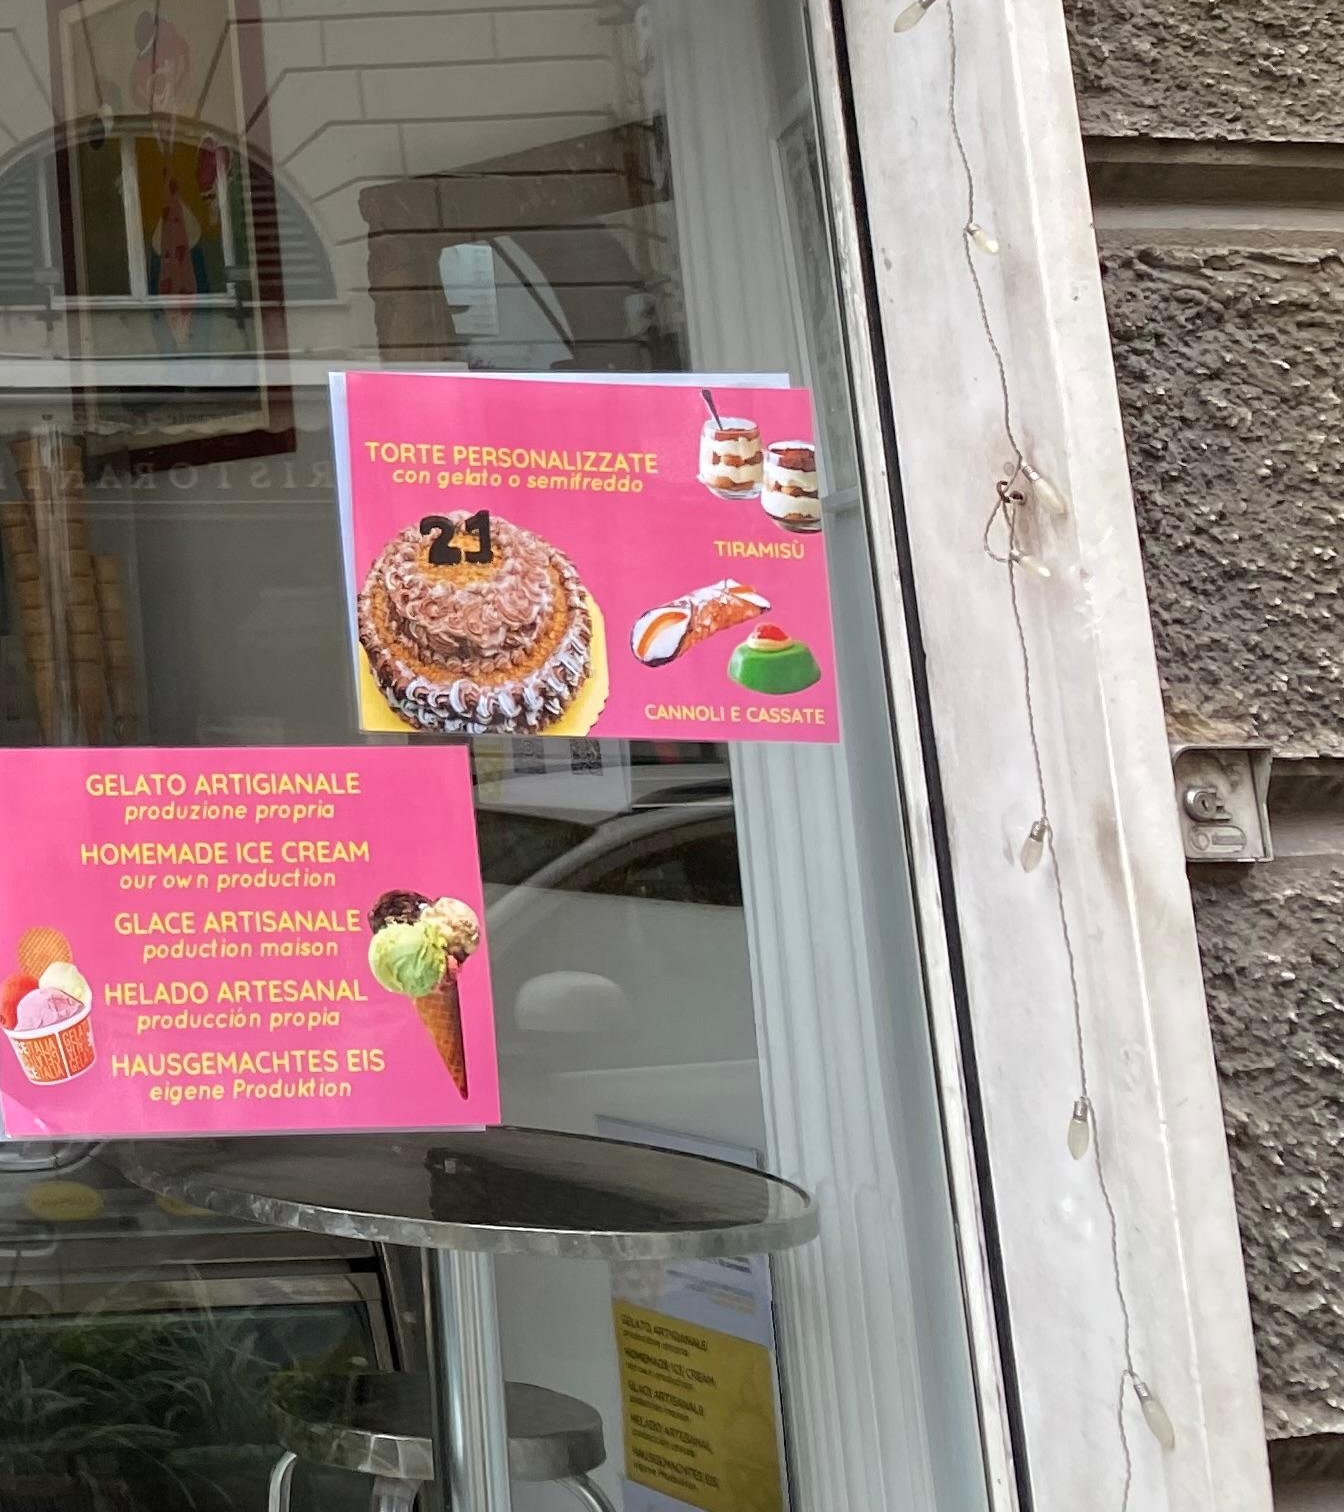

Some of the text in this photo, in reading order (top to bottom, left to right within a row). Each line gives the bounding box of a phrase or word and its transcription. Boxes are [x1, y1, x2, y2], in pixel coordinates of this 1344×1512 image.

[365, 440, 658, 476] TORTE PERSONALIZZATE
[392, 469, 644, 493] con gelato o semifreddo
[419, 510, 495, 566] 21
[714, 539, 807, 559] TIRAMISÙ
[644, 704, 825, 723] CANNOLI E CASSATE
[87, 772, 361, 797] GELATO ARTIGIANALE
[124, 801, 335, 823] produzione propria
[81, 841, 369, 864] HOMEMADE ICE CREAM
[120, 870, 336, 890] our own production
[115, 909, 361, 934] GLACE ARTISANALE
[143, 940, 337, 961] poduction maison
[104, 981, 368, 1004] HELADO ARTESANAL
[136, 1011, 340, 1033] producción propia
[112, 1050, 337, 1075] HAUSGEMACHTES
[347, 1049, 384, 1072] EIS
[150, 1079, 349, 1104] eigene Produktion
